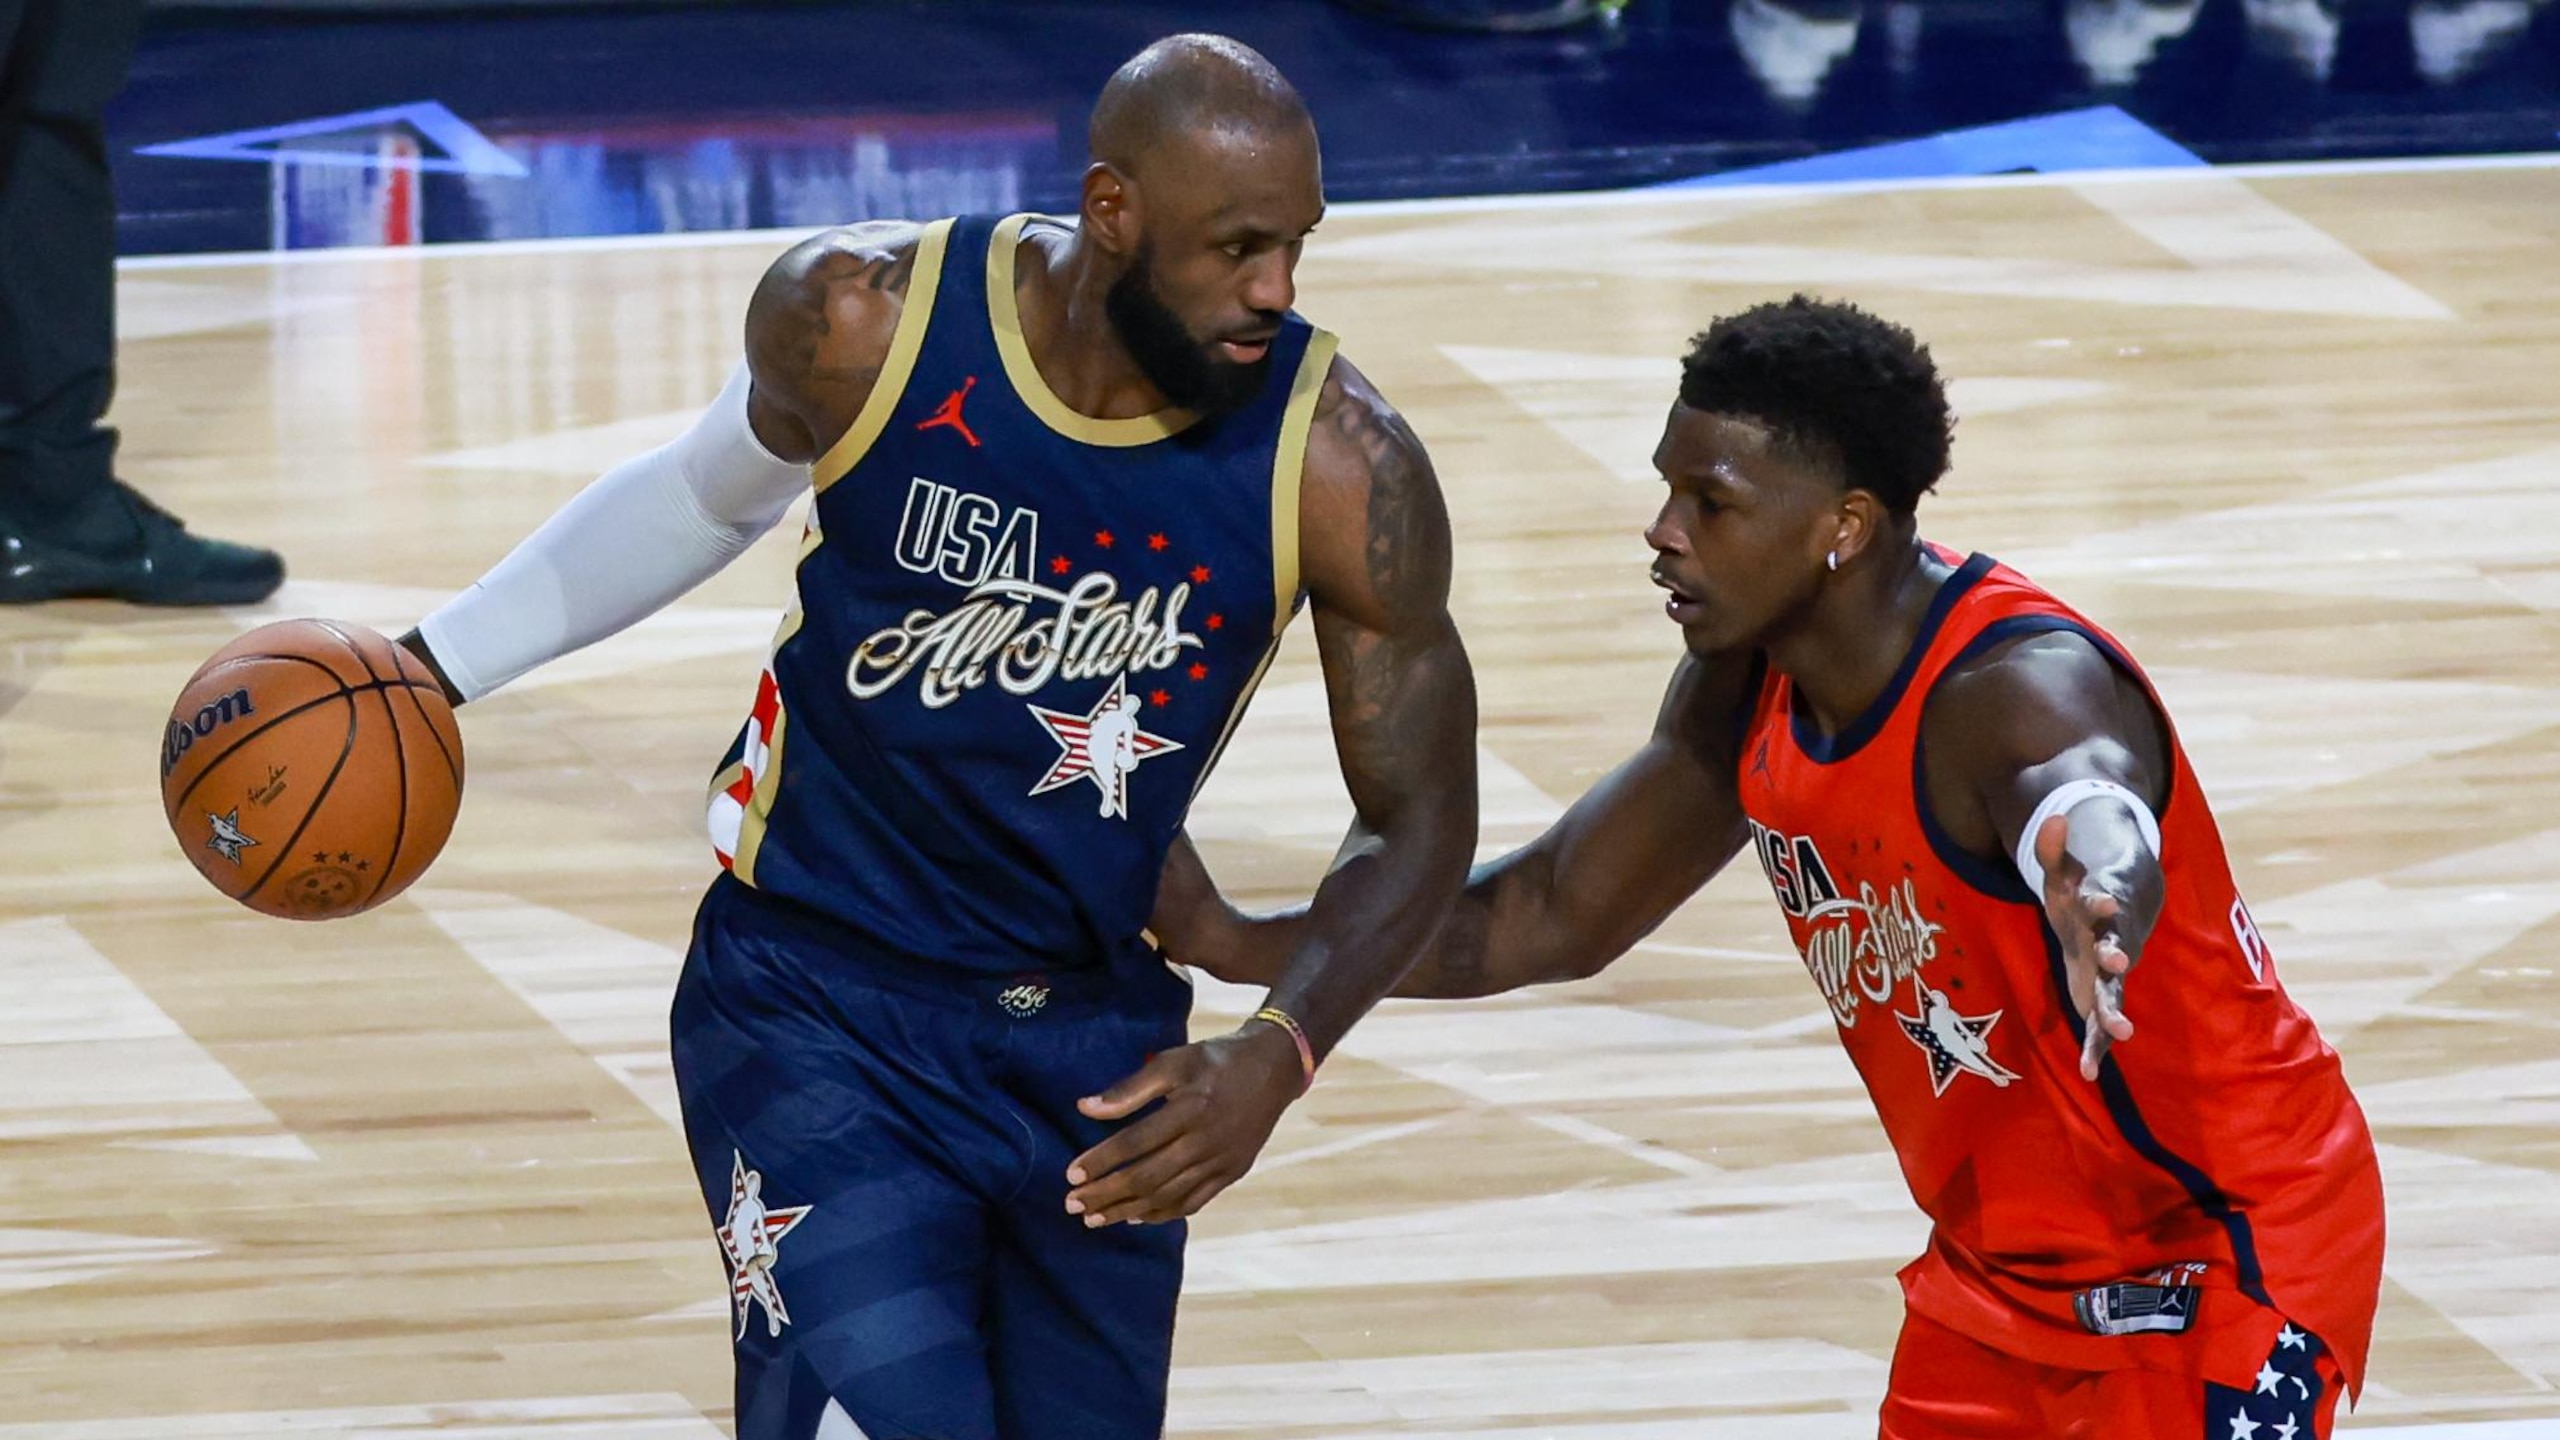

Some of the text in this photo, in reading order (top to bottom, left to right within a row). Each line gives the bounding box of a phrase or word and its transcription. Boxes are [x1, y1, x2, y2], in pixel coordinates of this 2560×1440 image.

[895, 477, 1038, 603] USA
[846, 572, 1204, 709] All Stars
